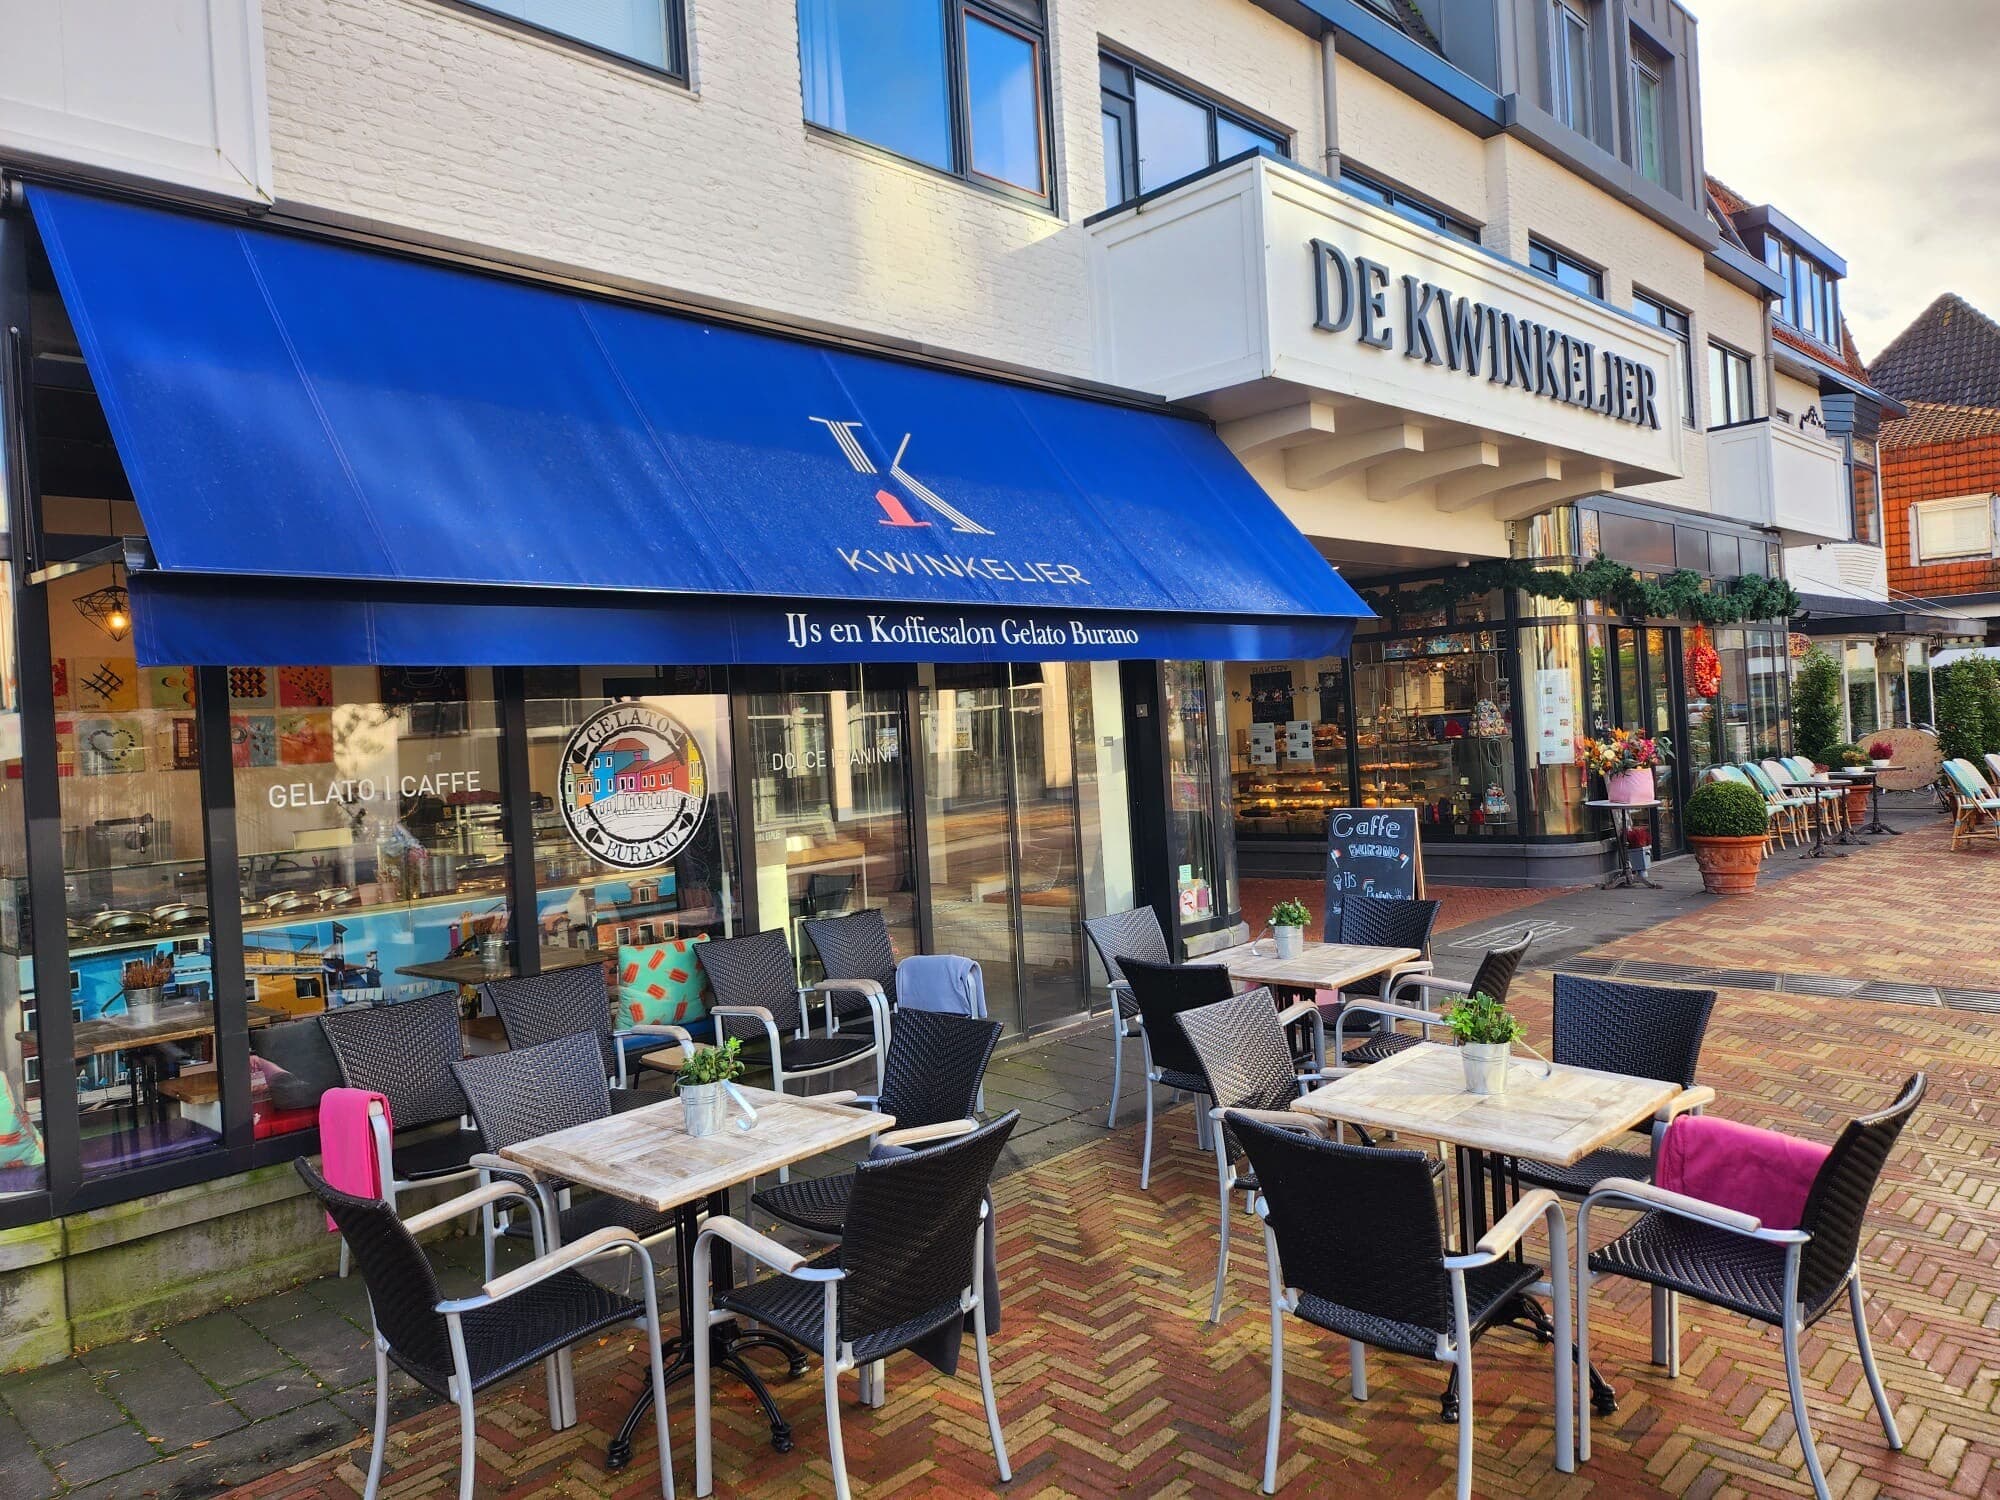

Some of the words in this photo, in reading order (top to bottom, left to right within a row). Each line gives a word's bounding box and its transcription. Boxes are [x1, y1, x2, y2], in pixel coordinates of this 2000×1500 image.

[1310, 238, 1392, 350] DE
[1401, 274, 1661, 431] KWINKELIER
[837, 547, 1091, 585] KWINKELIER
[785, 612, 822, 648] IJs
[830, 622, 862, 644] en
[867, 614, 997, 645] Koffiesalon
[1001, 618, 1066, 645] Gelato
[1069, 620, 1139, 645] Burano
[587, 709, 670, 743] GELATO
[268, 778, 376, 809] GELATO
[400, 770, 481, 798] CAFFE
[1332, 813, 1401, 839] Caffe
[603, 831, 679, 862] BURANO
